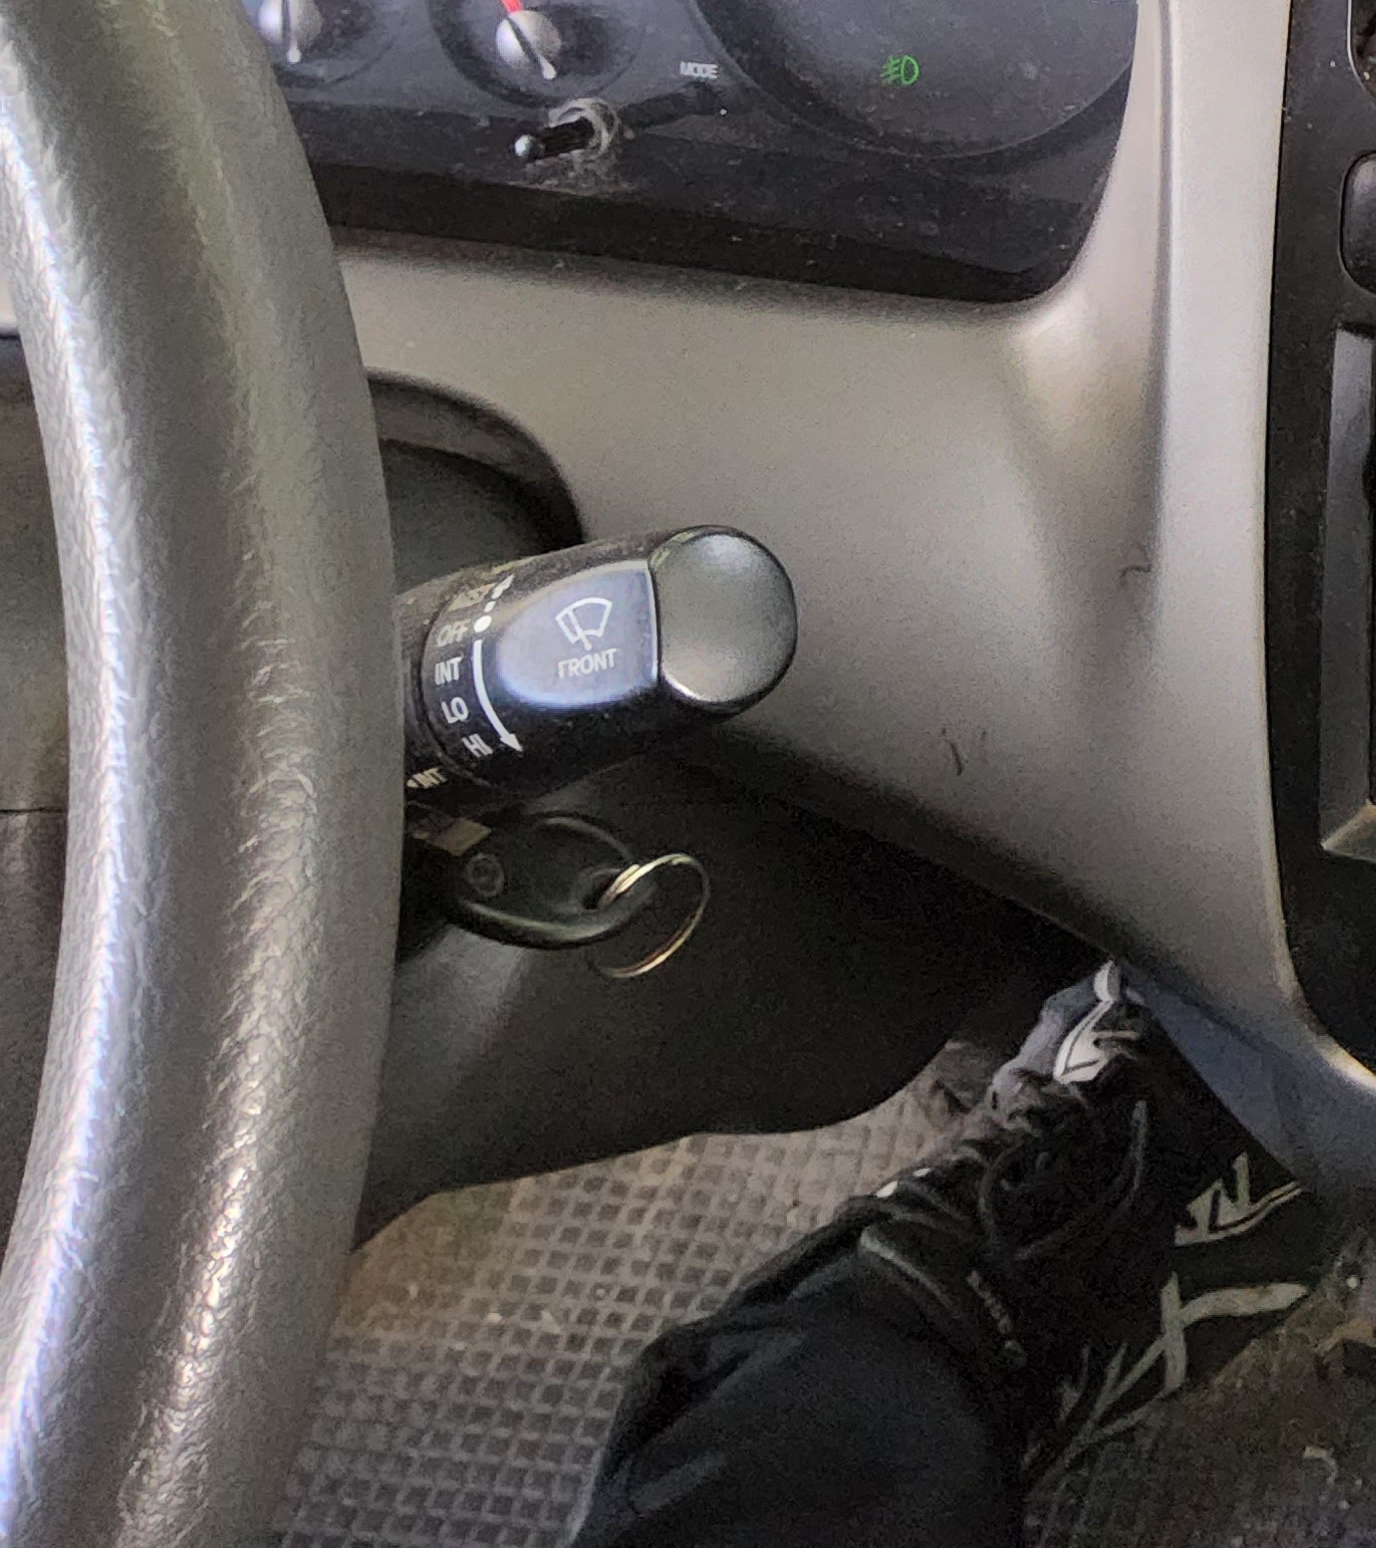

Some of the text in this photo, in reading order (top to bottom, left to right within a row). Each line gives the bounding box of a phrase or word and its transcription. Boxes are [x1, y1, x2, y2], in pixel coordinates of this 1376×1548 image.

[436, 618, 471, 648] OFF
[434, 656, 464, 686] INT
[556, 647, 618, 679] FRONT
[440, 697, 469, 724] LO
[461, 733, 494, 758] HI
